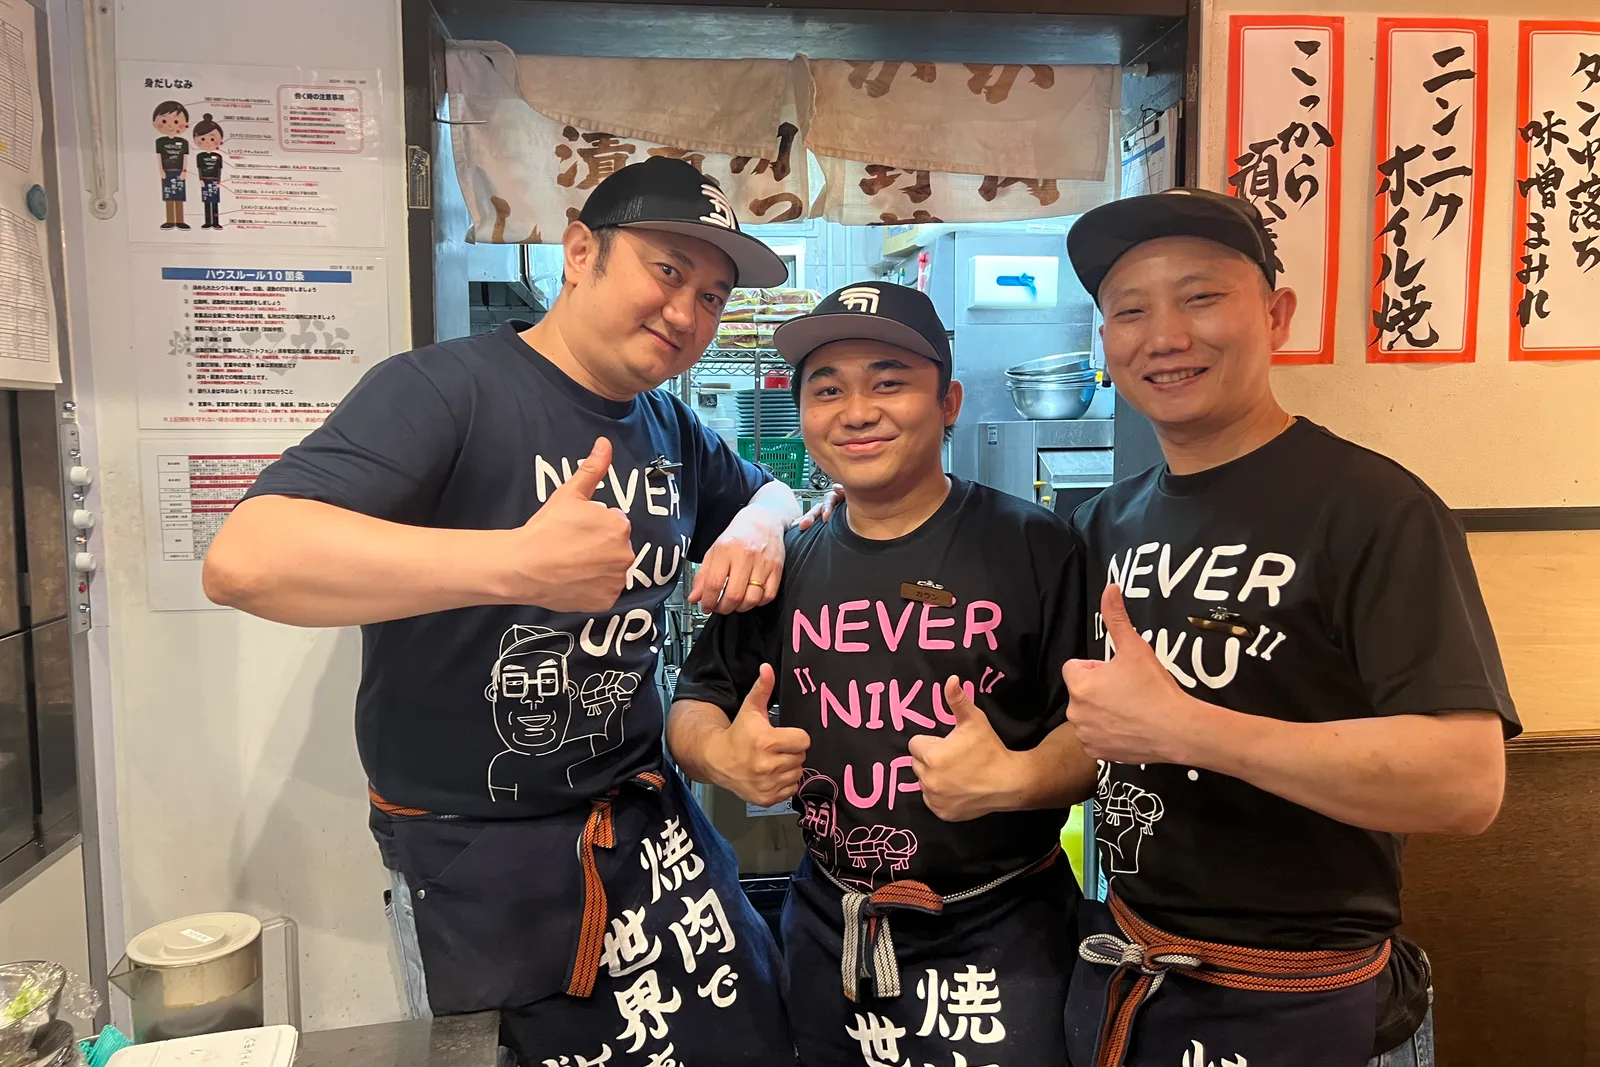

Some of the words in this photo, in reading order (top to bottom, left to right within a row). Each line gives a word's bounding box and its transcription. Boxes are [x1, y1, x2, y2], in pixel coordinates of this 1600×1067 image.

[144, 77, 193, 89] 身だしなみ
[1420, 46, 1477, 240] ニンニク
[1367, 144, 1440, 351] ホイル焼
[792, 599, 1003, 653] NEVER
[1106, 541, 1297, 607] NEVER
[640, 814, 738, 1009] 焼肉で
